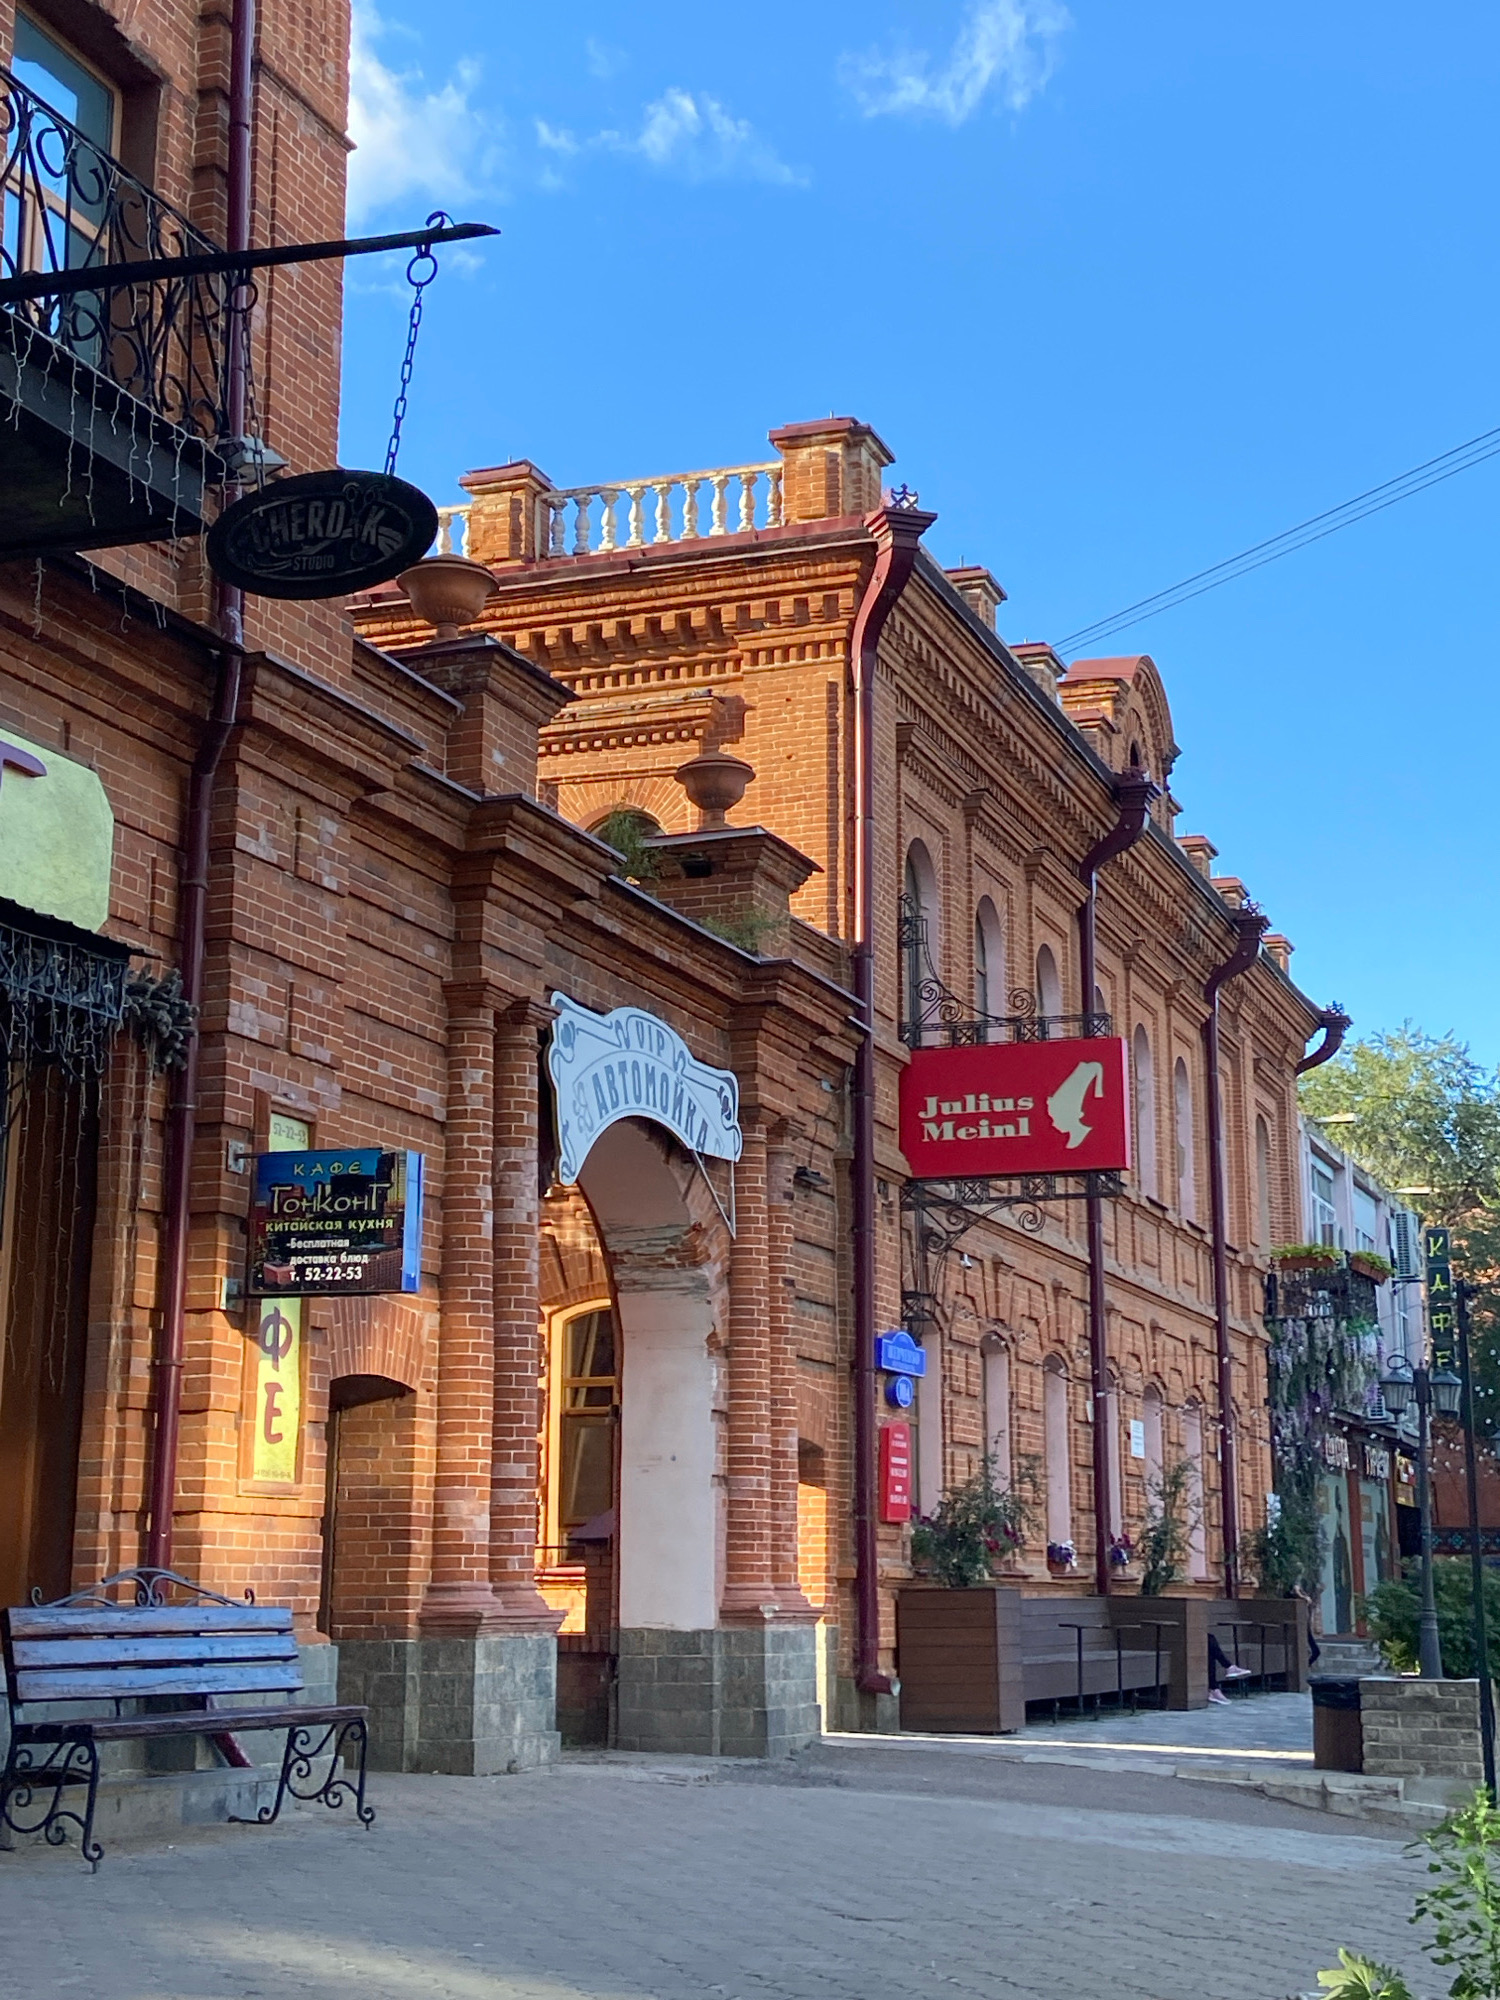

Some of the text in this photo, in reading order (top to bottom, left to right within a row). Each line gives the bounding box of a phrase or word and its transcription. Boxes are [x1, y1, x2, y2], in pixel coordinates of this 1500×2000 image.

[292, 554, 335, 571] STUDIO
[635, 1020, 665, 1057] VIP
[592, 1059, 708, 1152] АВТОМОЙКА
[918, 1093, 1034, 1119] Julius
[922, 1117, 1031, 1142] Meinl
[293, 1161, 362, 1176] КАФЕ
[265, 1217, 394, 1233] китайская кухня
[290, 1253, 337, 1265] доставка
[304, 1266, 363, 1281] 52-22-53
